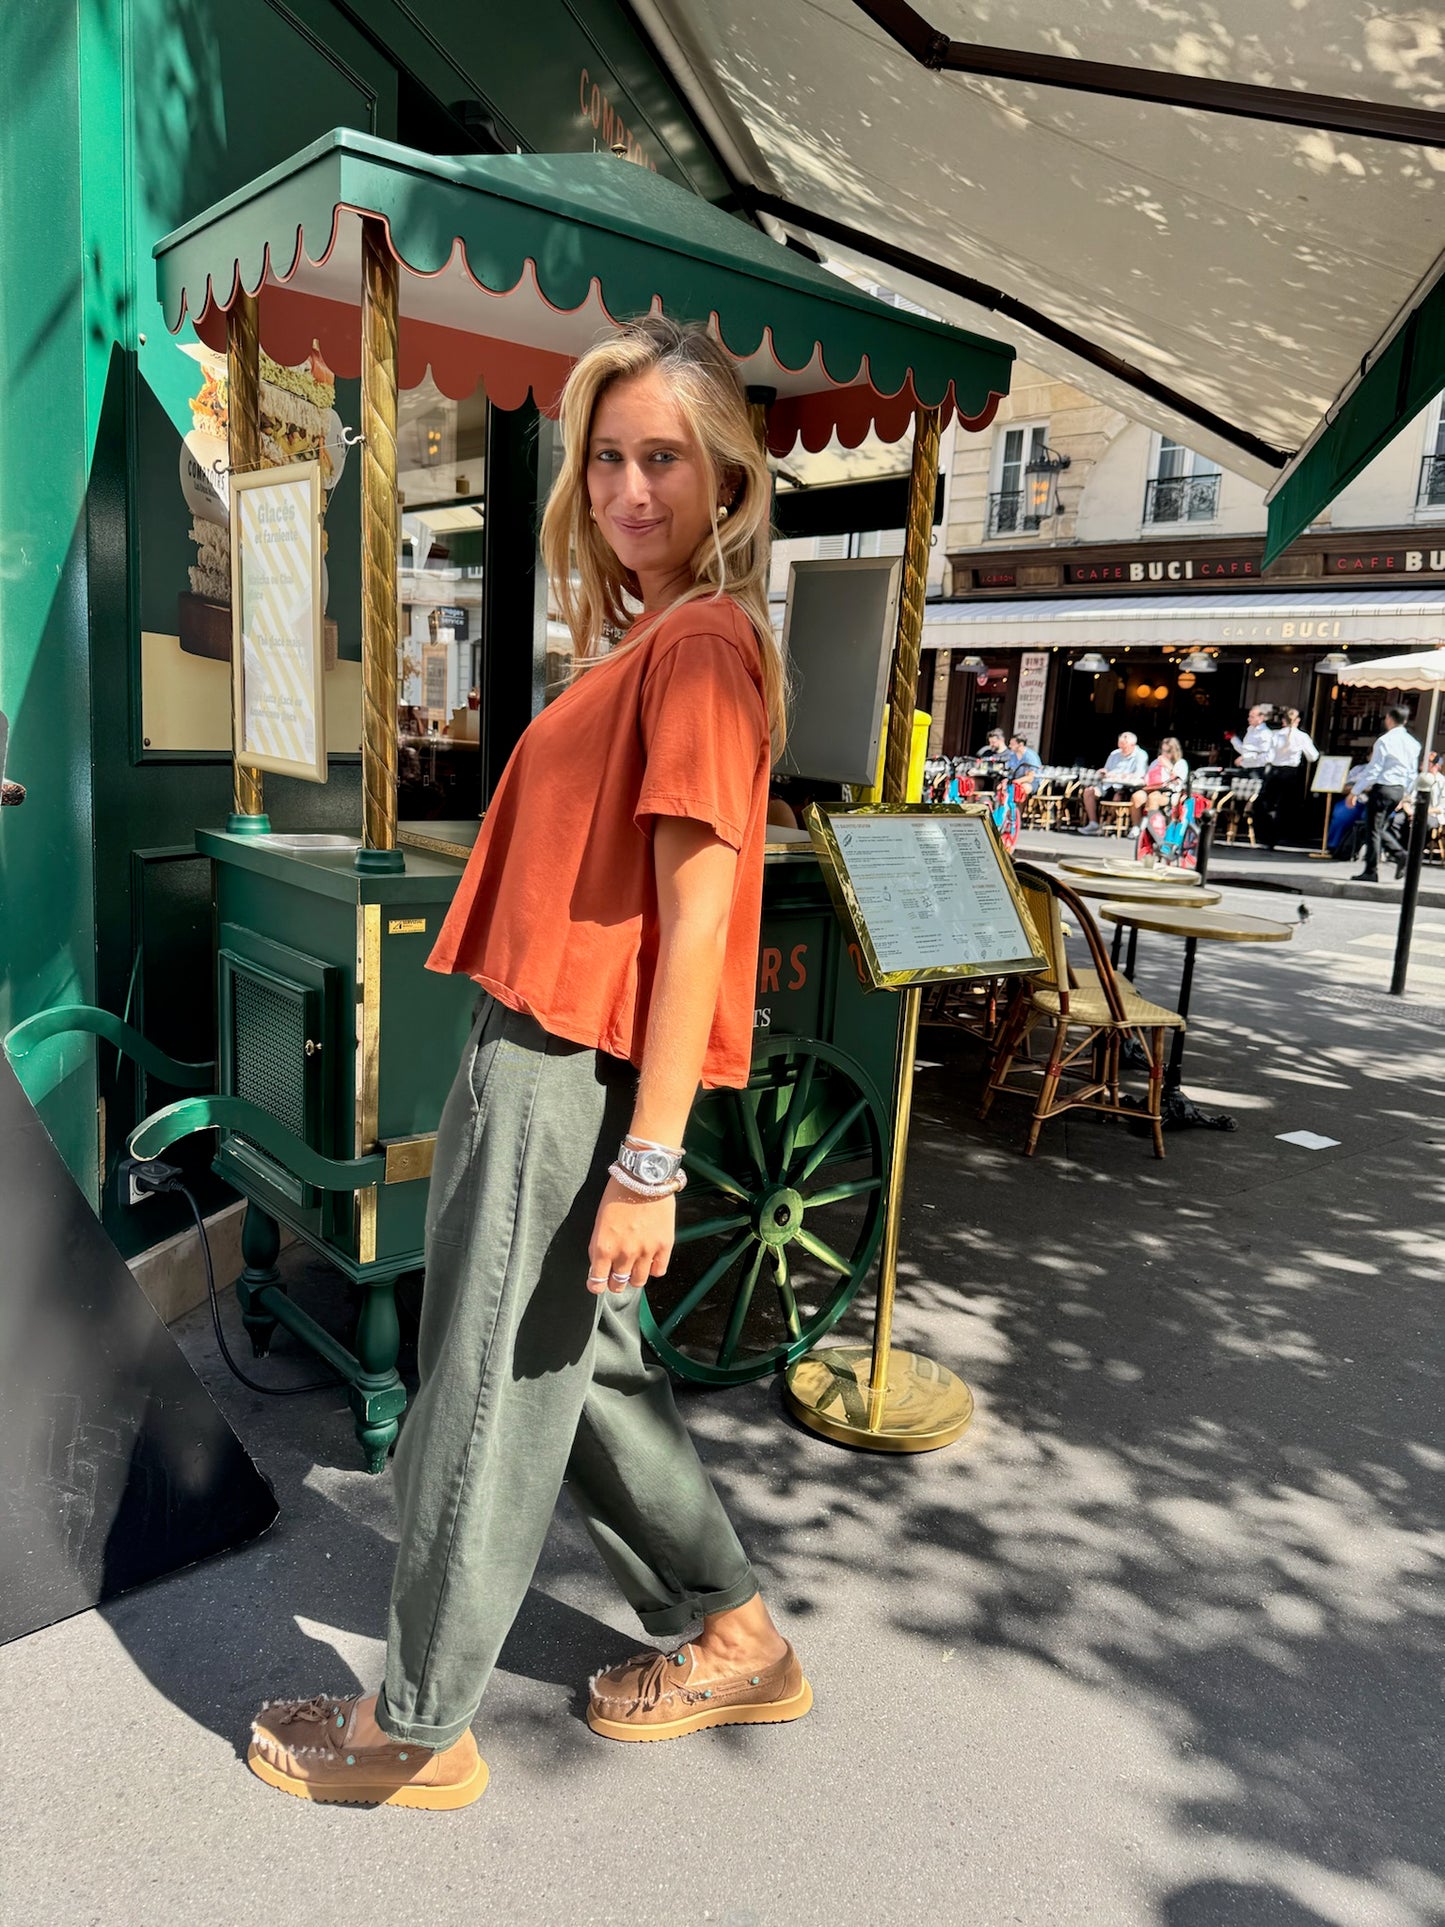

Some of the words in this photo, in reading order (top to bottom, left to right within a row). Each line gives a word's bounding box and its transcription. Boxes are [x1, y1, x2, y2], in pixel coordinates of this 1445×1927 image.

[1077, 568, 1122, 579] CAFE
[1129, 560, 1193, 581] BUCI
[1201, 562, 1253, 575] CAFE
[1337, 557, 1395, 569] CAFE
[1223, 627, 1272, 636] CAFE
[1281, 622, 1341, 638] BUCI
[760, 943, 808, 994] RS
